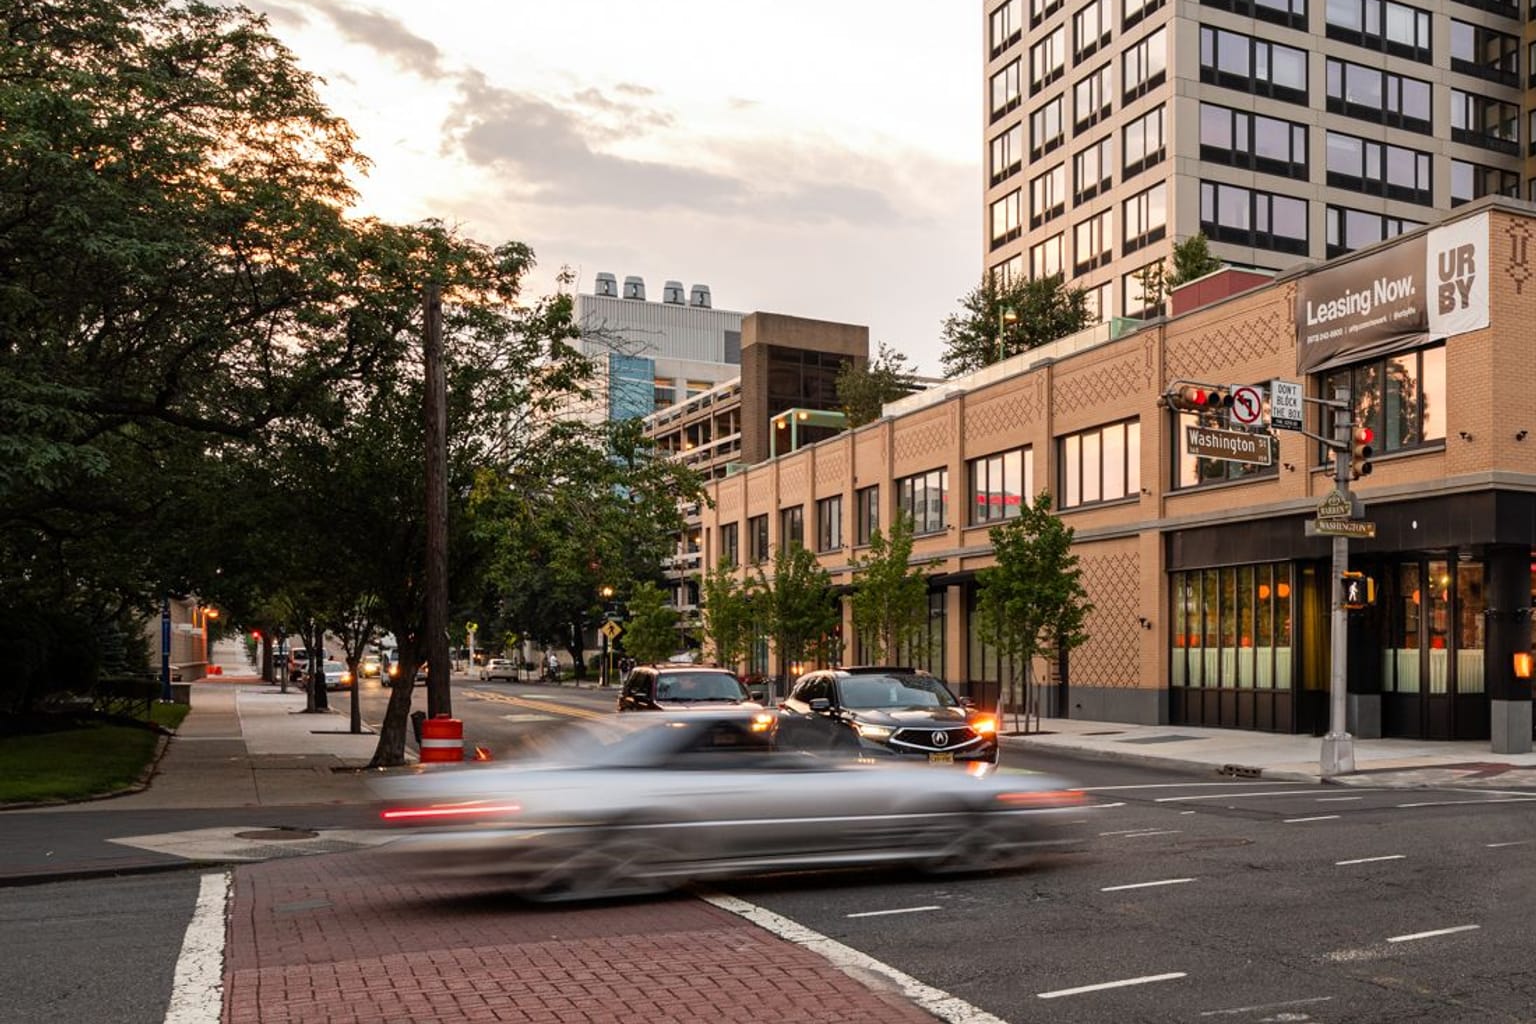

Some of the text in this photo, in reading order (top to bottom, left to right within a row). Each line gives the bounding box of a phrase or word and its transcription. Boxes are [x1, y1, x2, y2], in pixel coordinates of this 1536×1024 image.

[1307, 289, 1371, 326] Leasing
[1374, 275, 1416, 307] Now.
[1273, 407, 1285, 417] THE
[1189, 429, 1256, 455] Washington
